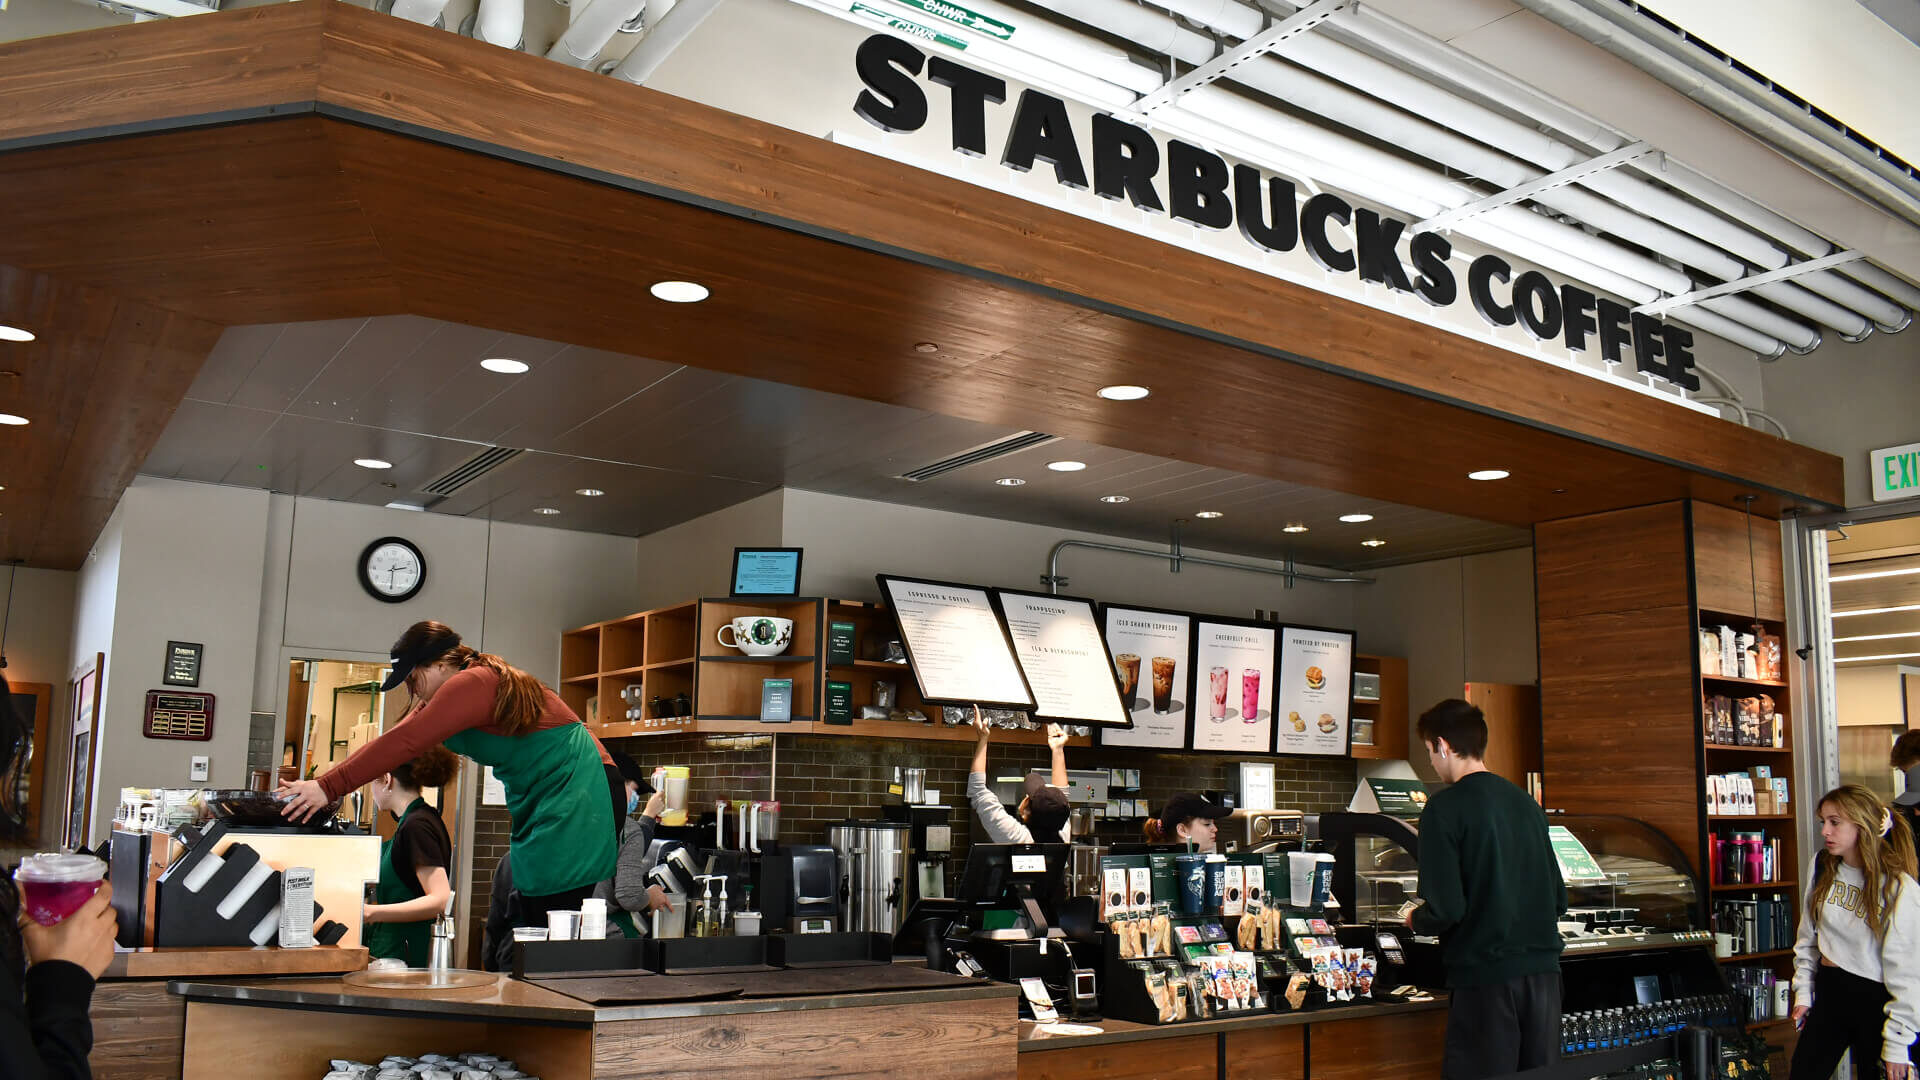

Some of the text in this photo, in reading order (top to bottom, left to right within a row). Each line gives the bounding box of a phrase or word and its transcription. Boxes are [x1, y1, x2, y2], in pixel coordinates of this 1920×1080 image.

[922, 0, 968, 23] CHWR
[894, 21, 937, 42] CHWS
[853, 33, 1700, 392] STARBUCKS COFFEE
[1884, 451, 1920, 491] EXI
